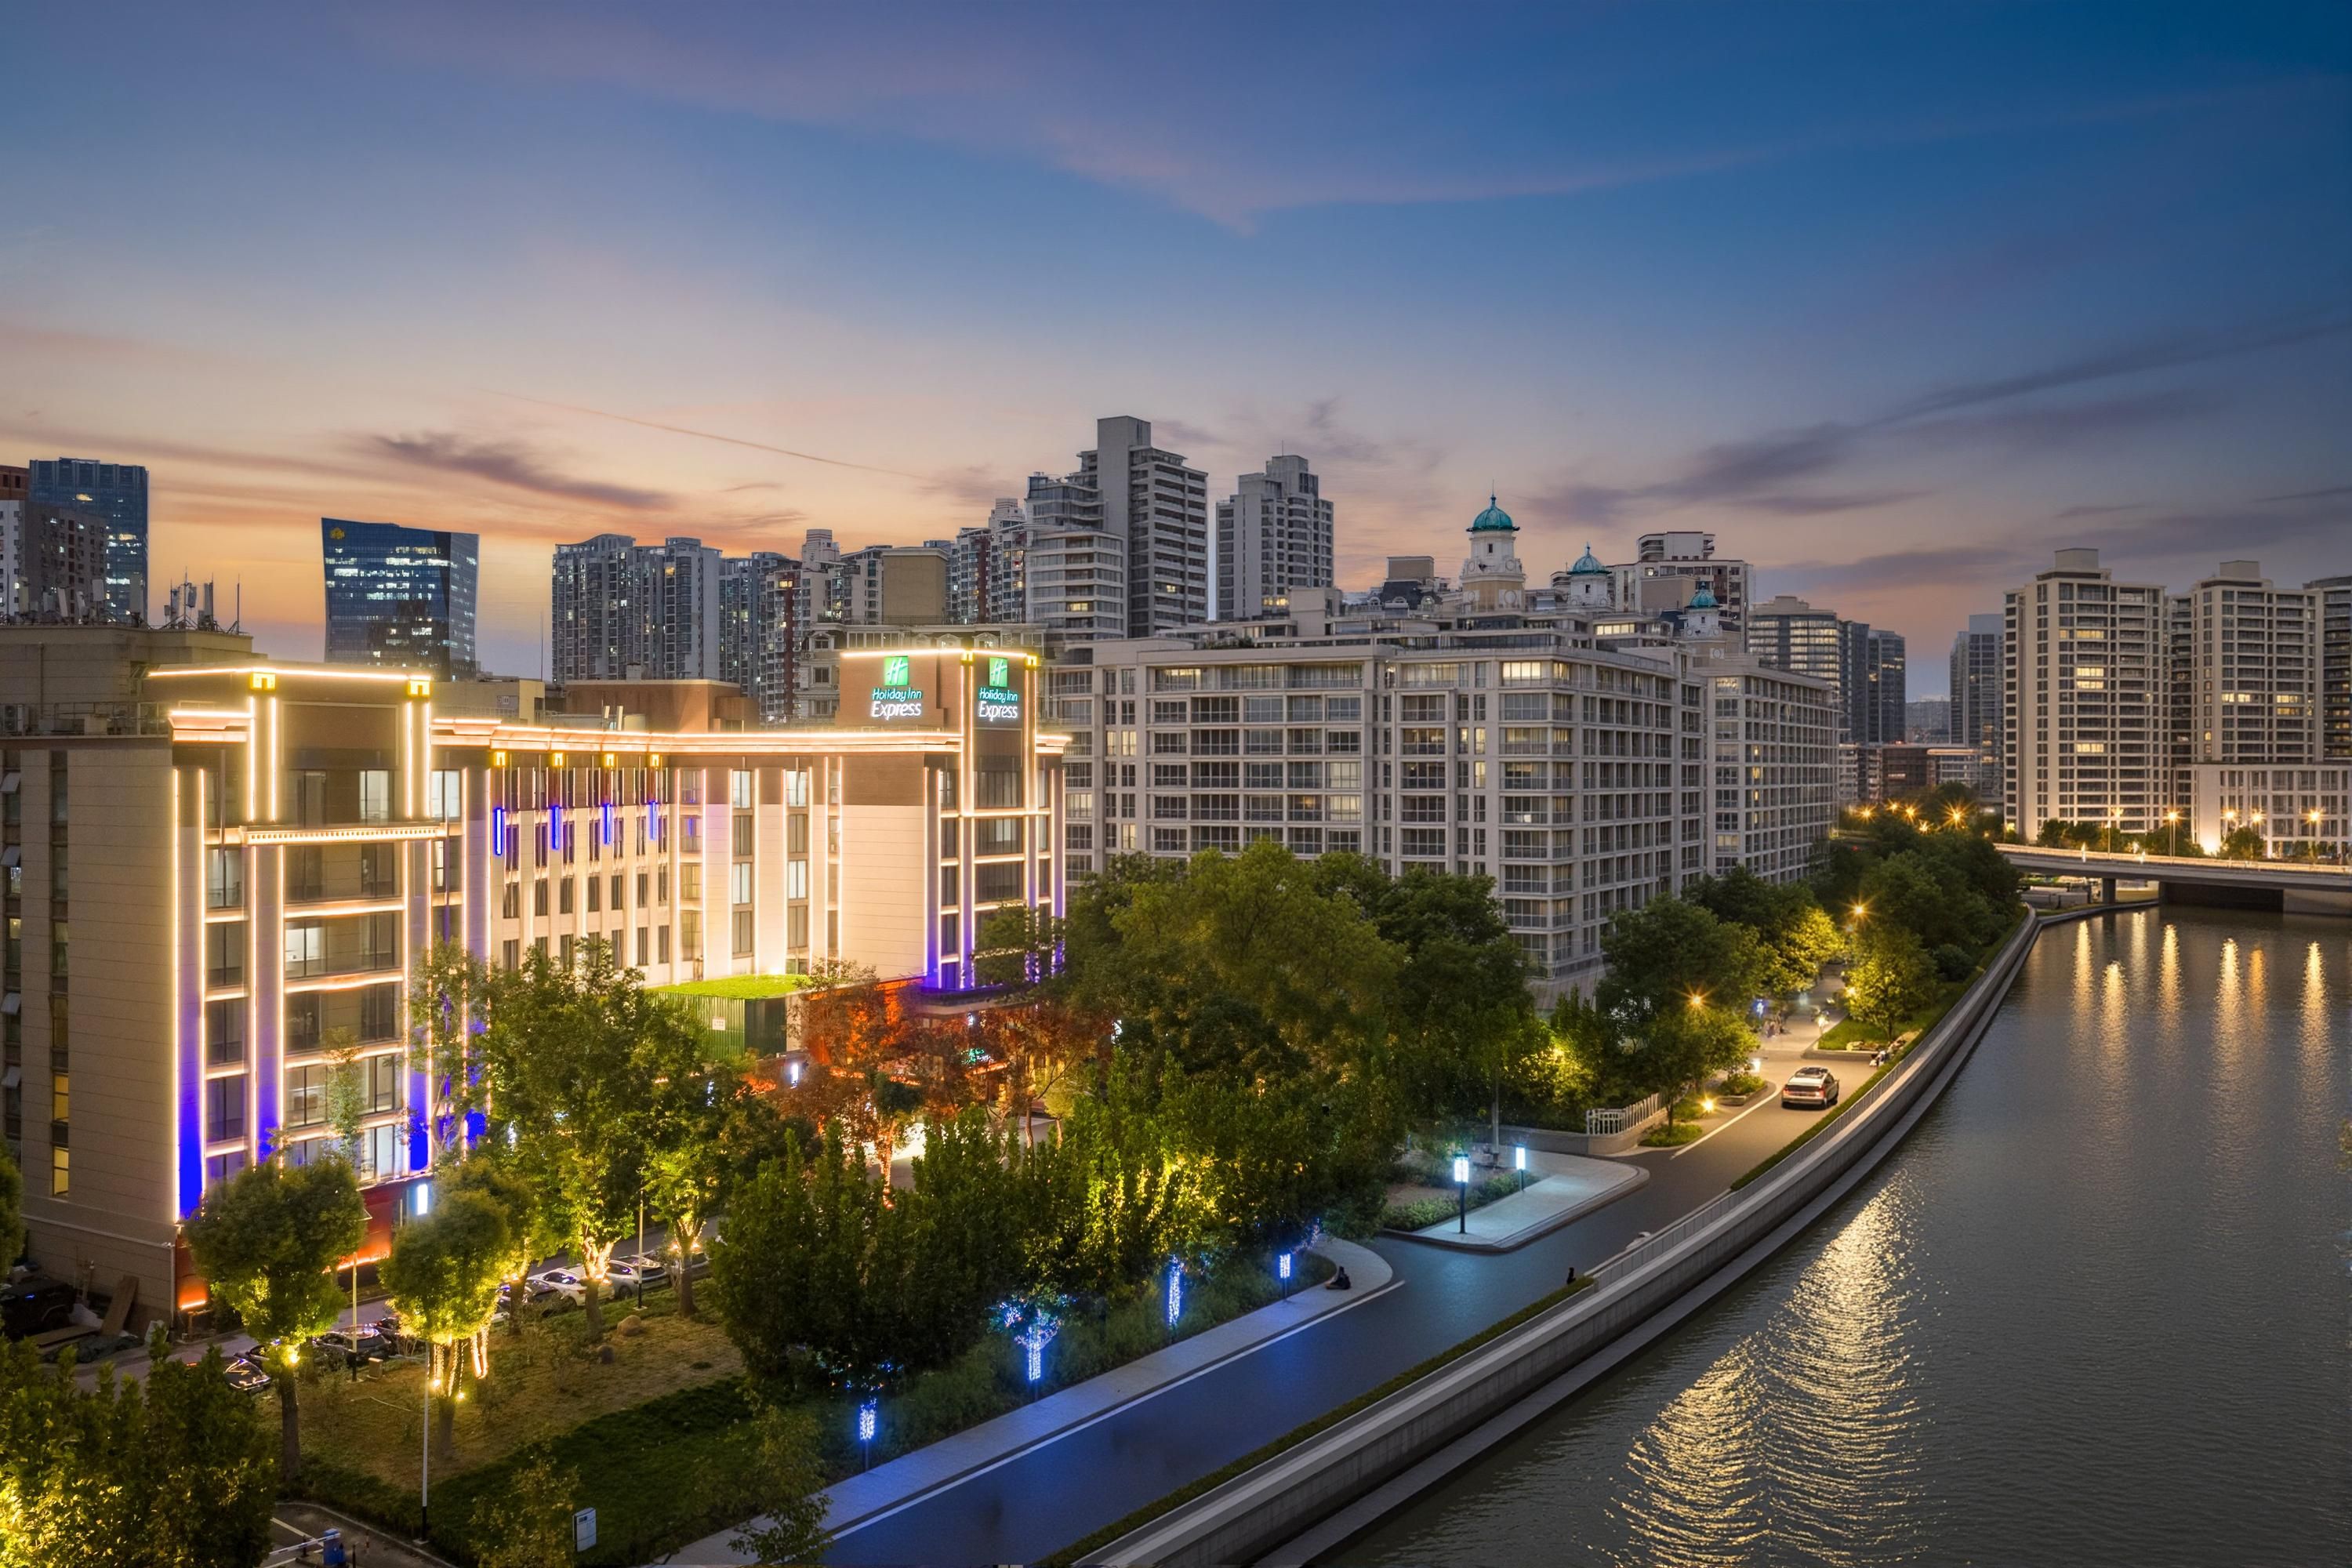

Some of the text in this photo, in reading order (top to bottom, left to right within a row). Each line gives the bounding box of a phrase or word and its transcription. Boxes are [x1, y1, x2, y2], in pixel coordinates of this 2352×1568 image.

[872, 688, 922, 702] Holiday Inn
[979, 688, 1018, 703] Holiday Inn
[870, 700, 922, 720] Express
[978, 700, 1018, 721] Express
